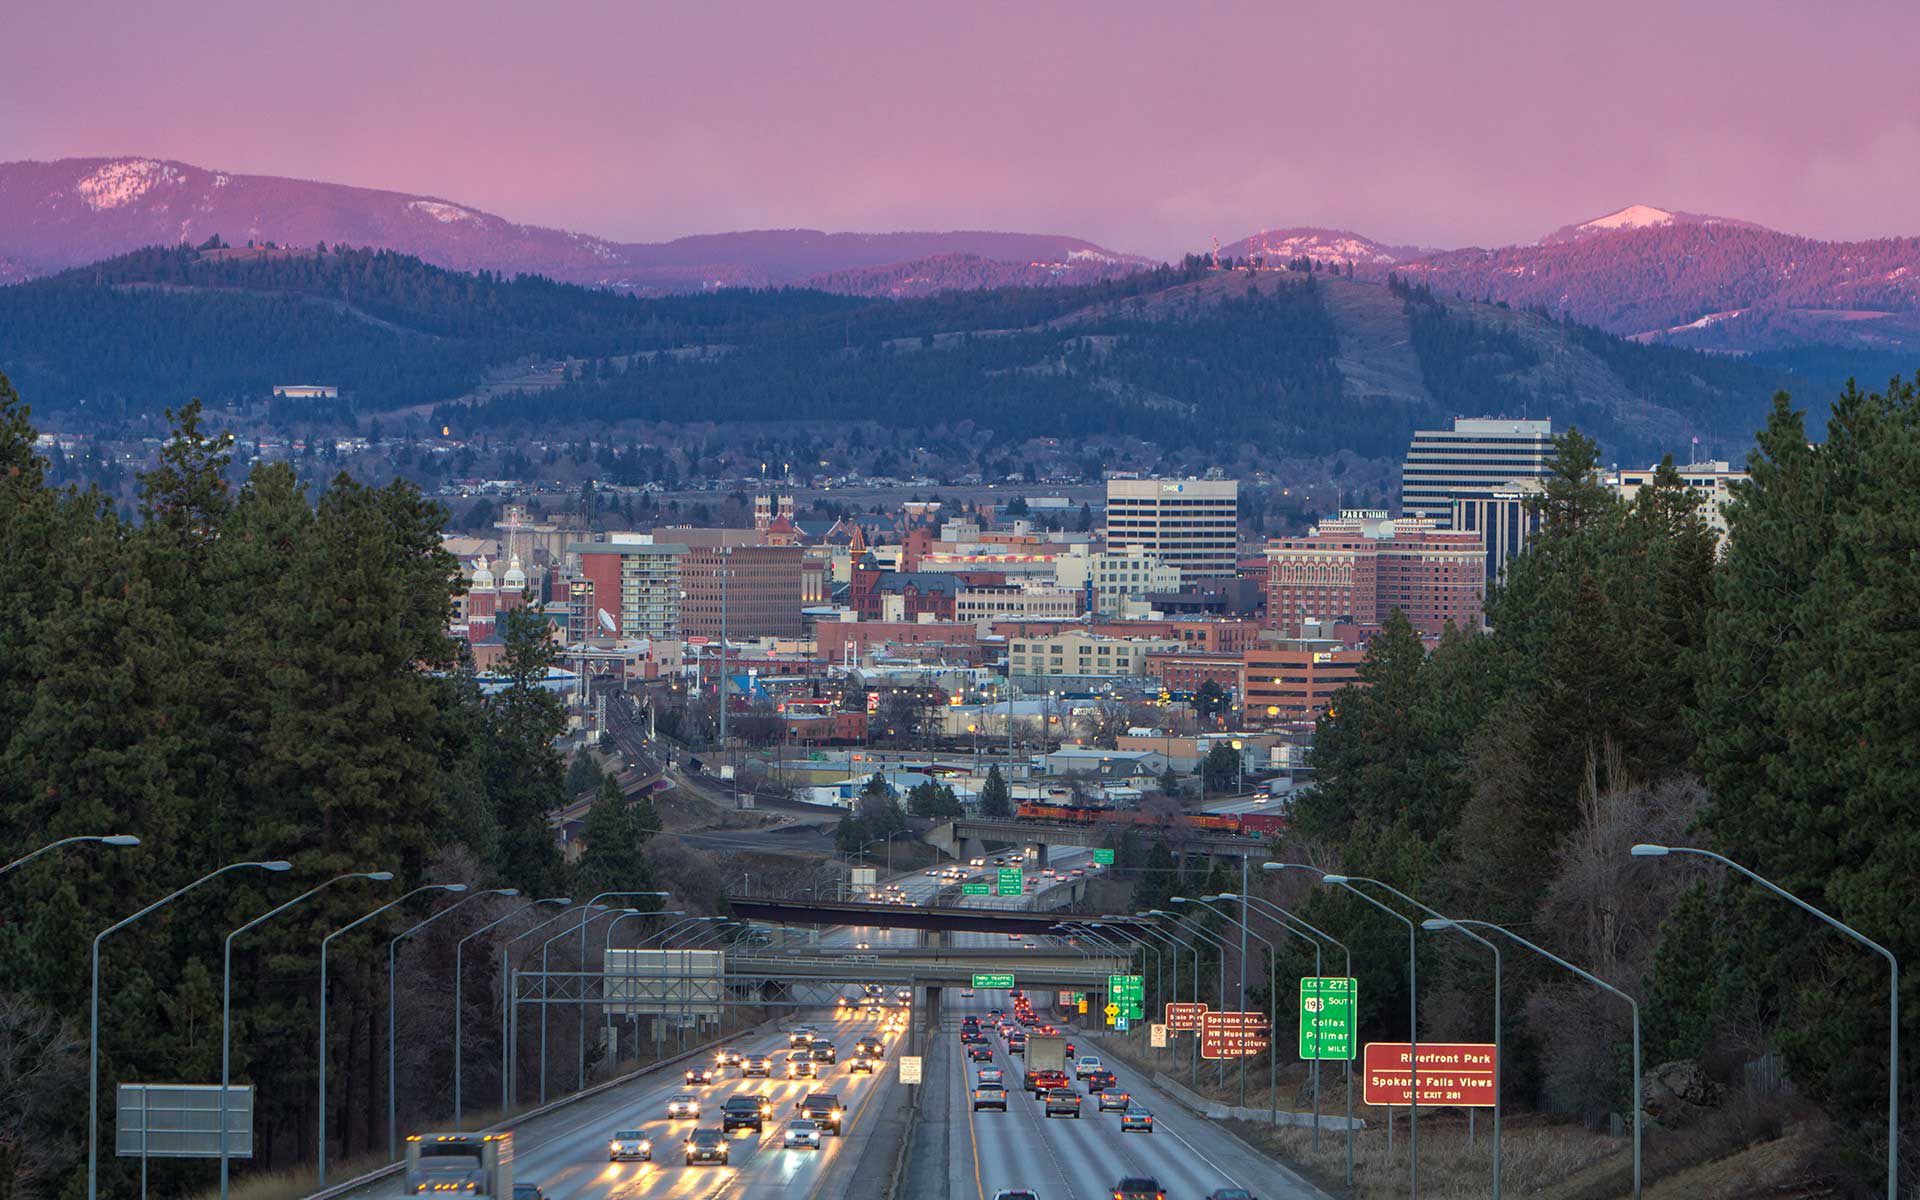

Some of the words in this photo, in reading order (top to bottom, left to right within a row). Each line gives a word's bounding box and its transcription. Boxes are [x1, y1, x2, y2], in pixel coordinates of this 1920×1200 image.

[1117, 1017, 1125, 1027] H
[1244, 1016, 1268, 1024] Area
[1328, 1045, 1347, 1053] MILE
[1400, 1053, 1459, 1063] Riverfront
[1464, 1054, 1491, 1063] Park
[1372, 1077, 1421, 1087] Spokane
[1426, 1077, 1454, 1087] Falls
[1460, 1078, 1493, 1087] Views
